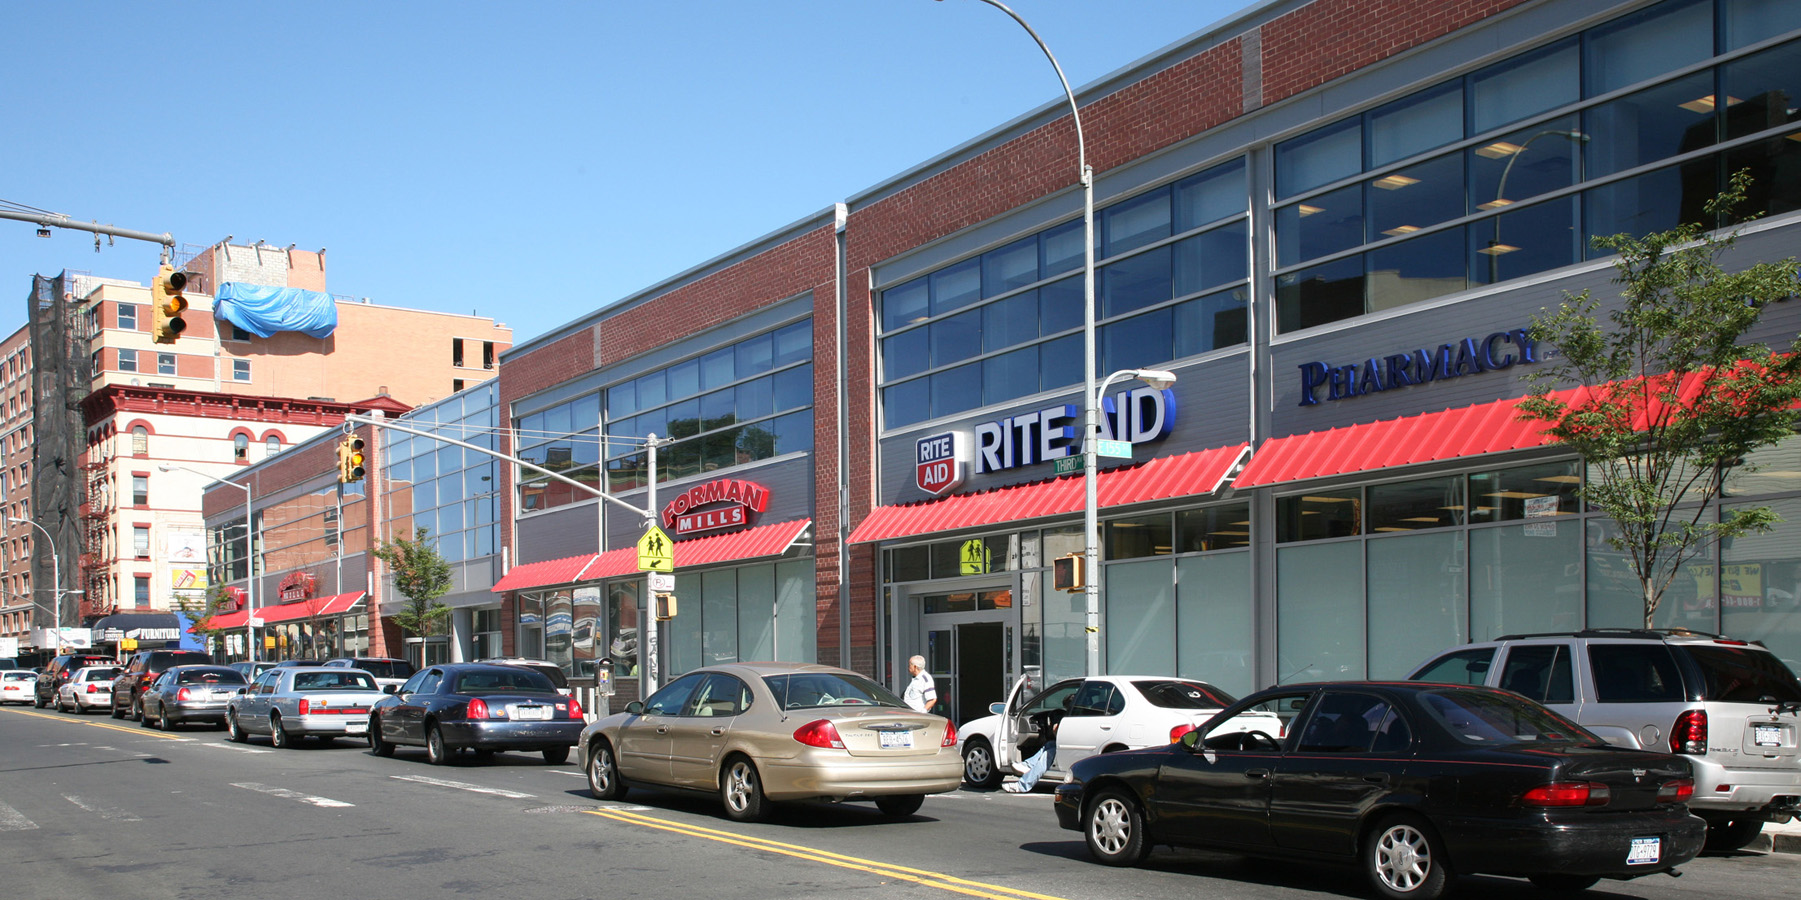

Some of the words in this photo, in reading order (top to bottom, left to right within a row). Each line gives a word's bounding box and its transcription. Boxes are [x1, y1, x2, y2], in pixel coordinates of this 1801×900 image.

[1298, 328, 1535, 407] PHARMACY
[975, 404, 1072, 475] RITE
[1081, 385, 1172, 454] AID
[920, 436, 950, 462] RITE
[1097, 441, 1104, 454] E
[1105, 442, 1121, 455] 155
[923, 463, 949, 486] AID
[1056, 457, 1077, 473] THIRD
[661, 479, 765, 530] FORMAN
[679, 507, 742, 532] MILLS
[140, 628, 180, 640] FURNITURE
